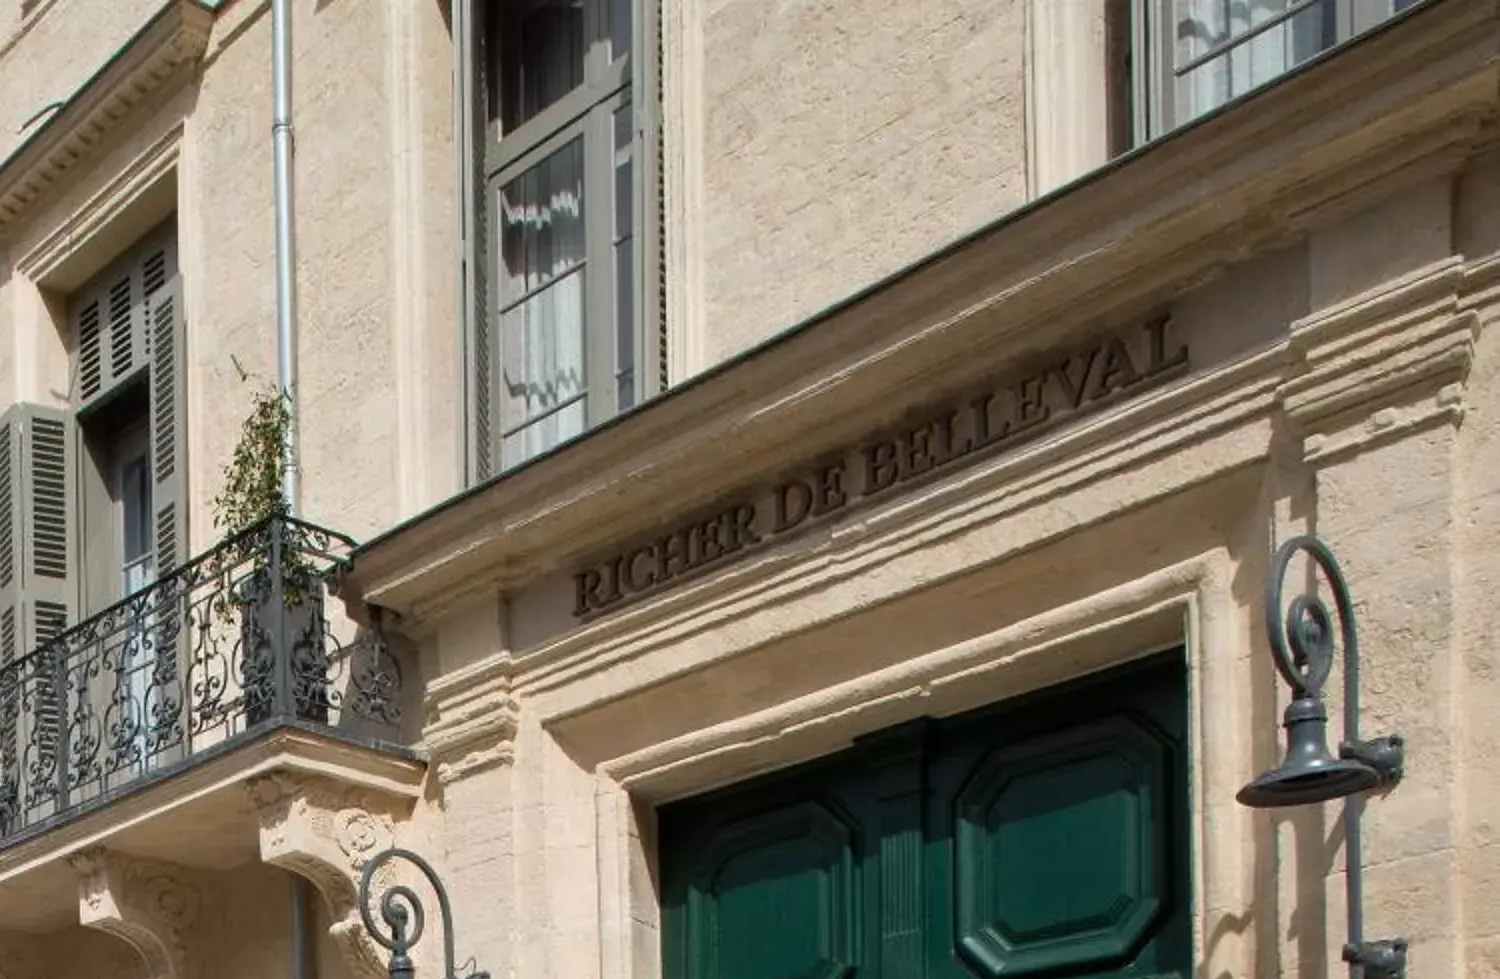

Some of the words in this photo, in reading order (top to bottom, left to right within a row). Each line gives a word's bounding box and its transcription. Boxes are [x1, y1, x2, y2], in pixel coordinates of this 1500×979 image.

[571, 508, 762, 618] RICHER
[773, 466, 848, 536] DE
[860, 313, 1190, 497] BELLEVAL
